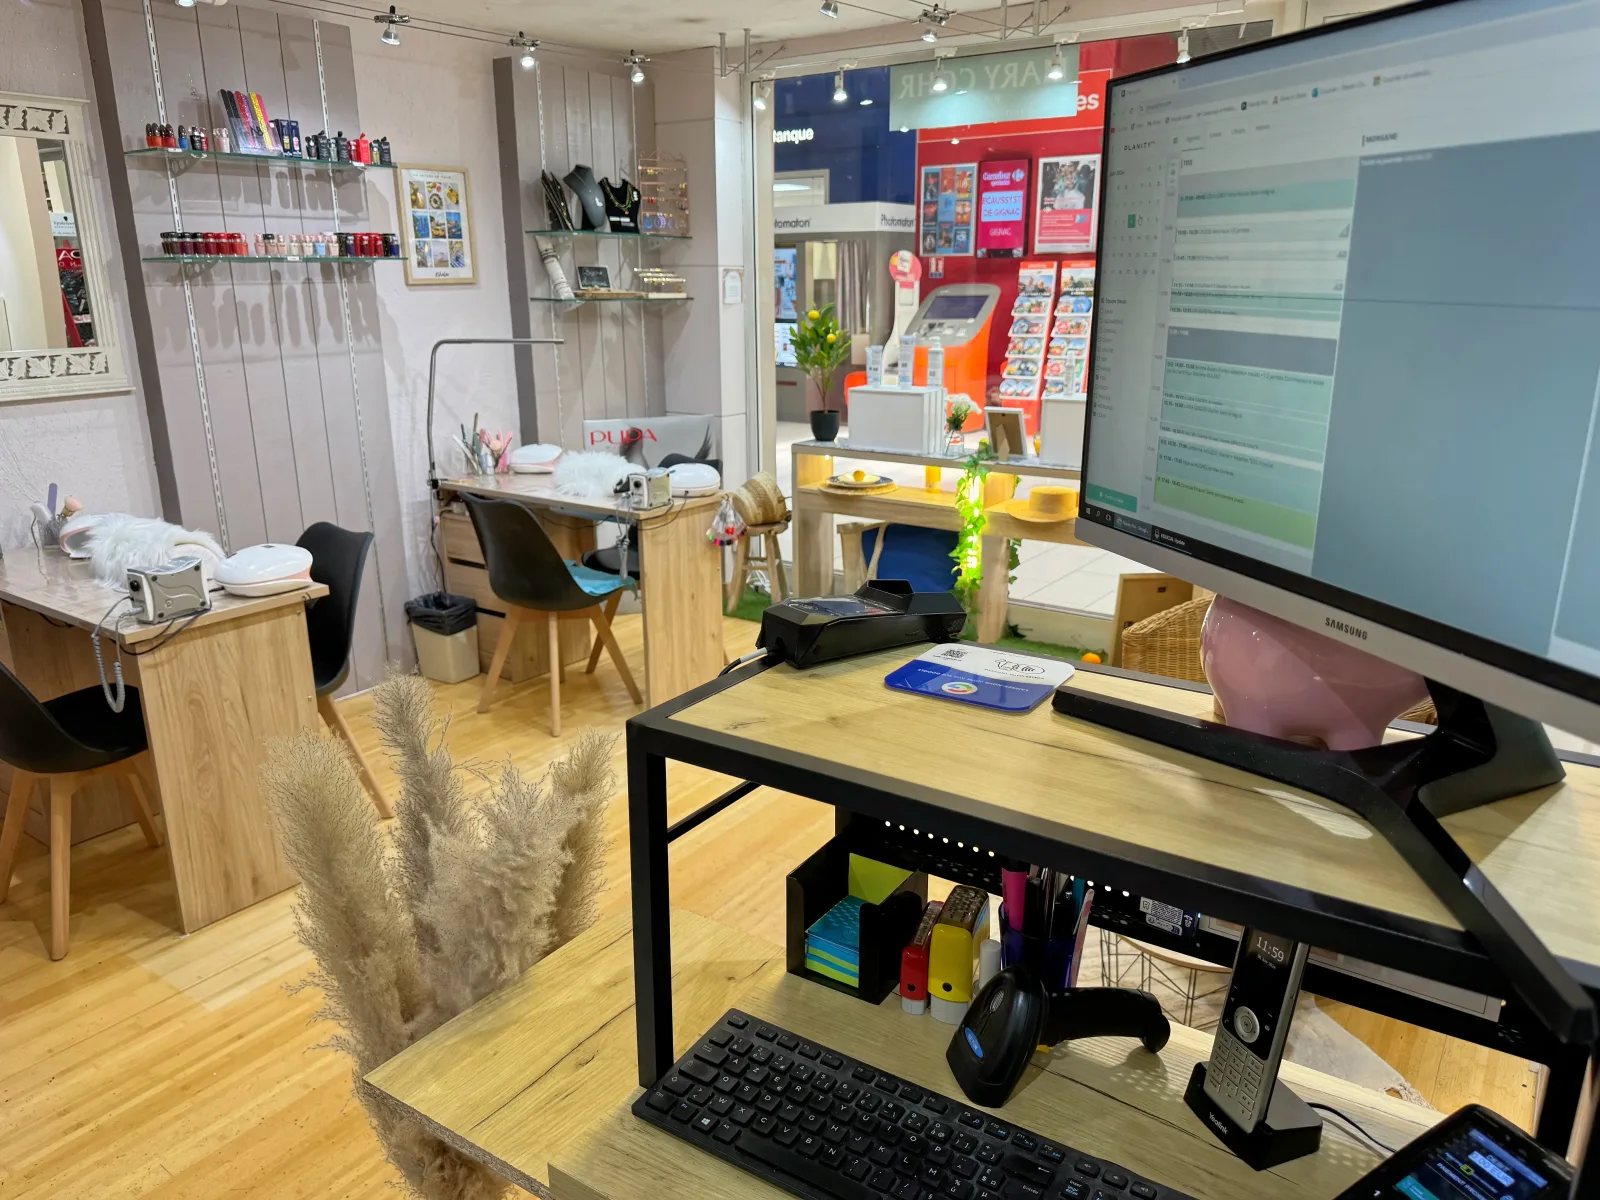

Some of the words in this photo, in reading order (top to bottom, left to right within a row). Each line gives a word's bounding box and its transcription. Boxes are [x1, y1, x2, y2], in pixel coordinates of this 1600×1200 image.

[589, 428, 659, 446] PUPA
[1325, 617, 1368, 640] SAMSUNG
[1256, 936, 1284, 962] 11:59
[1209, 1111, 1229, 1135] Yealink
